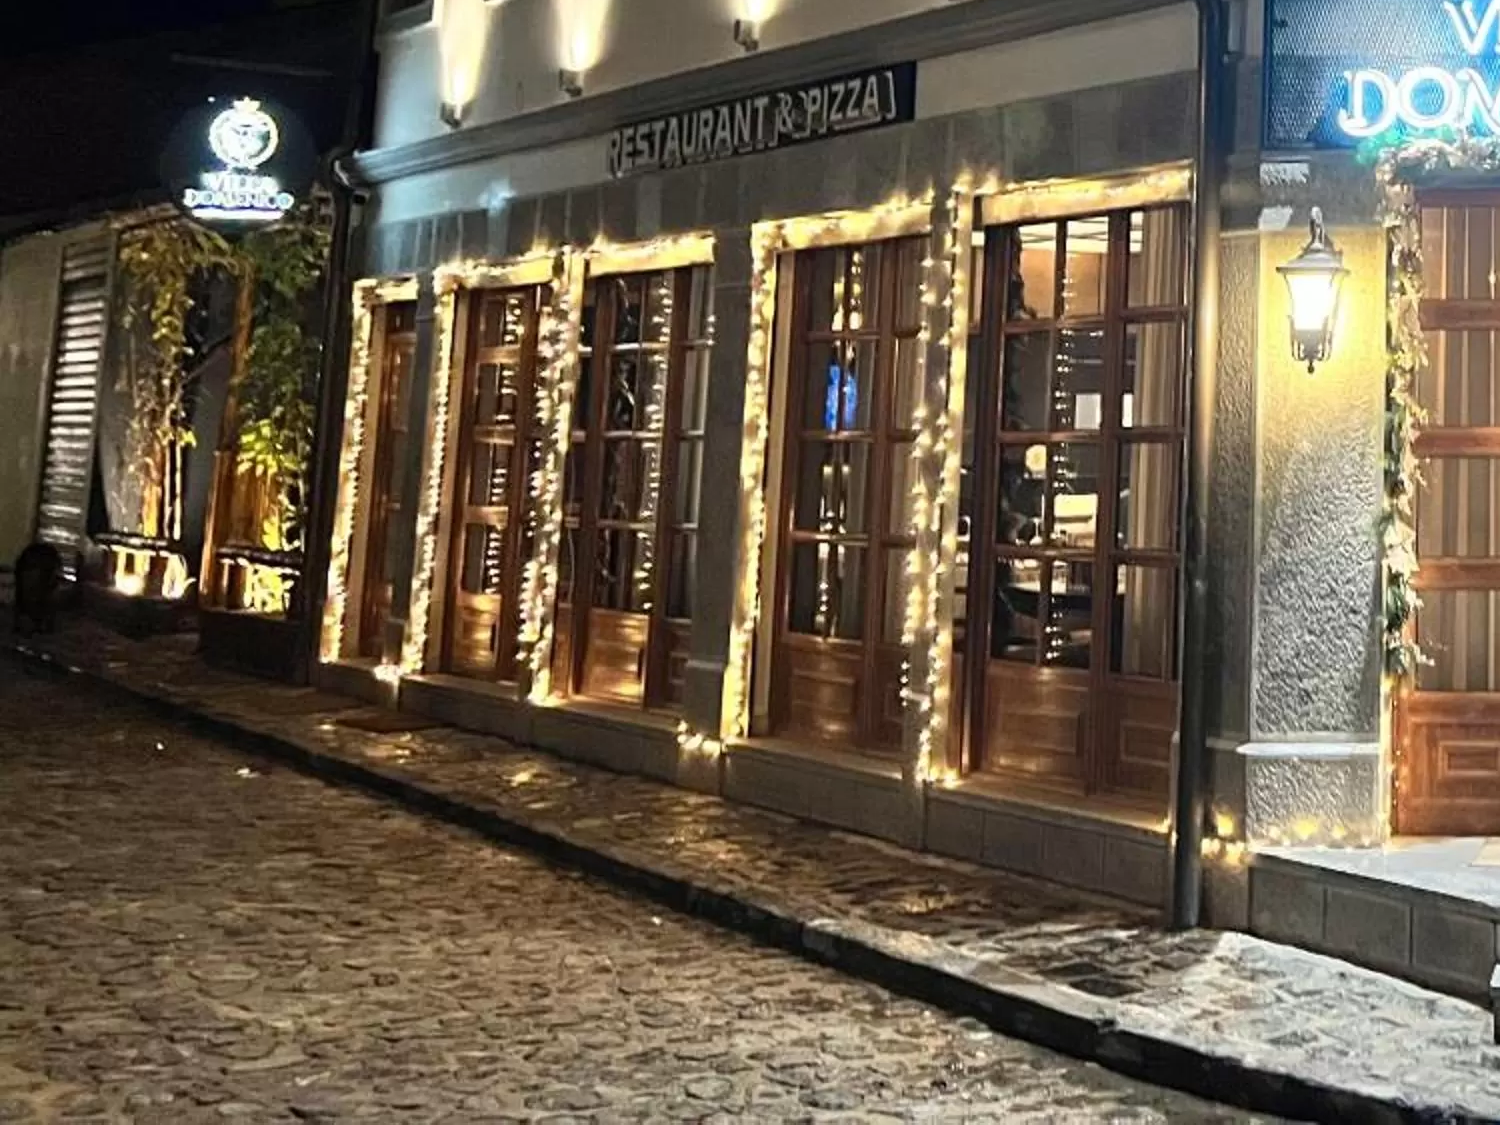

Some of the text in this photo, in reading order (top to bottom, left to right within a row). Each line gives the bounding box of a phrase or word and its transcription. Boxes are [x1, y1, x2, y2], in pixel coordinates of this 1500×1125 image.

[610, 74, 880, 174] RESTAURANT & PIZZA
